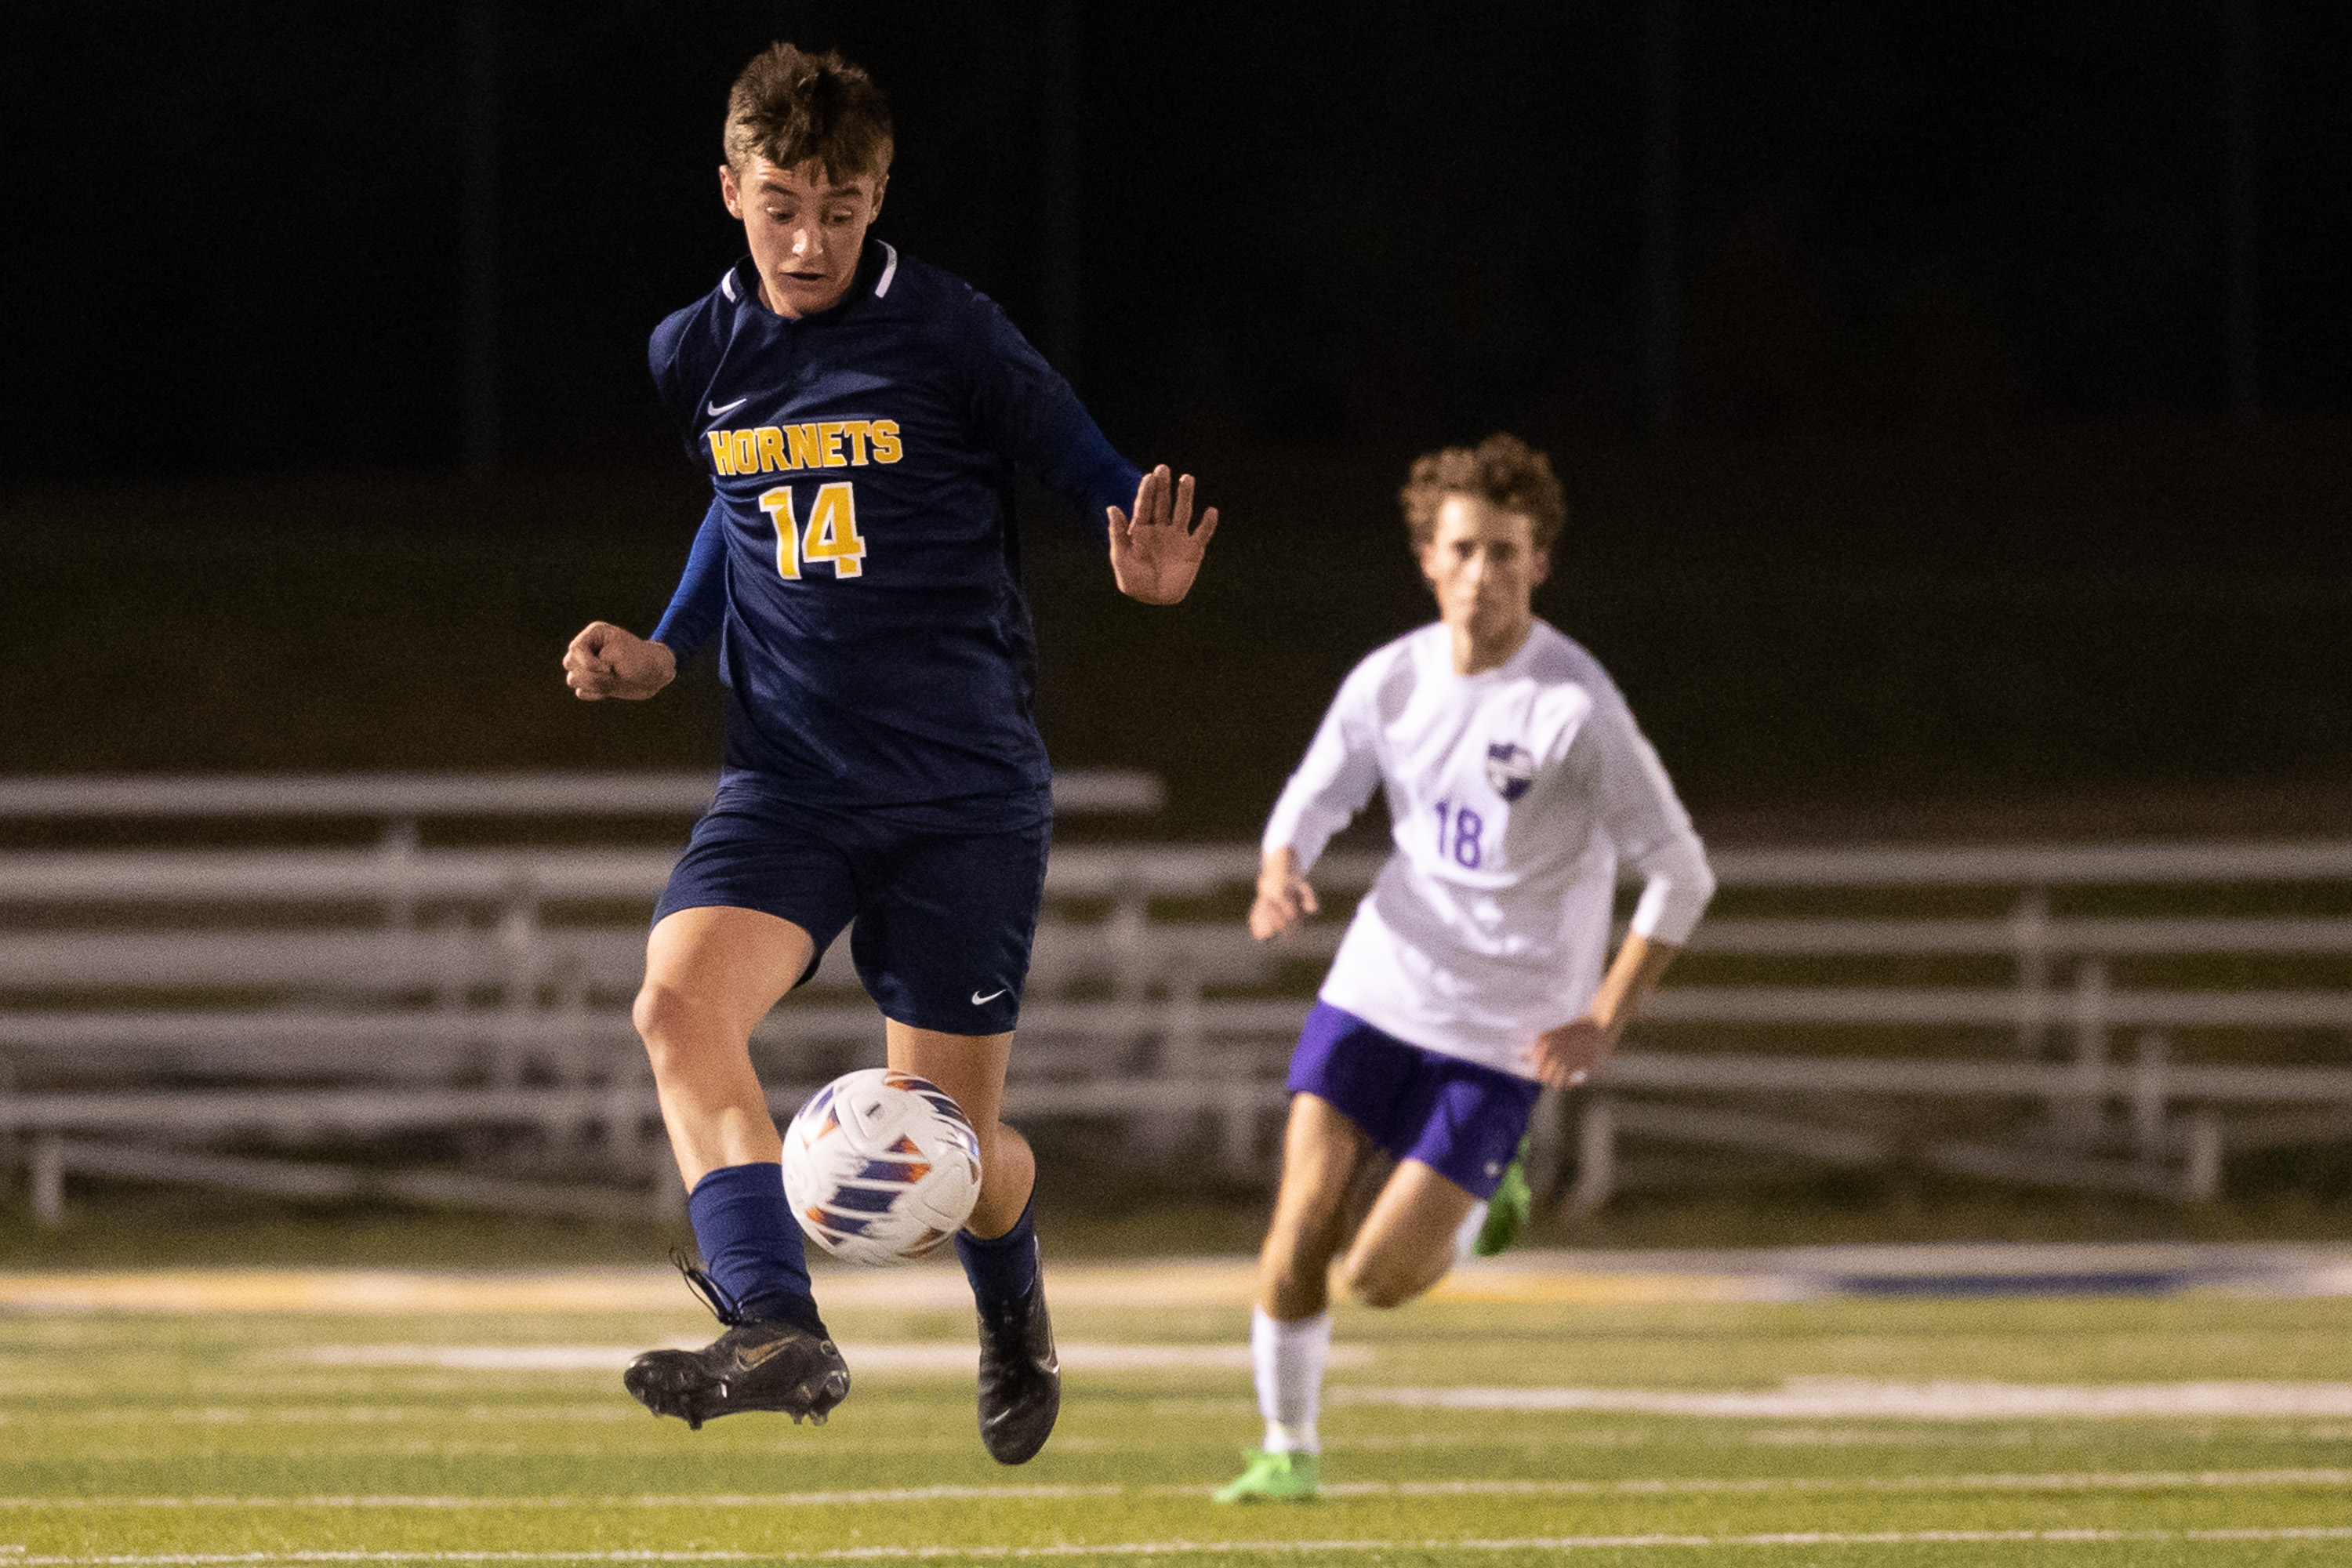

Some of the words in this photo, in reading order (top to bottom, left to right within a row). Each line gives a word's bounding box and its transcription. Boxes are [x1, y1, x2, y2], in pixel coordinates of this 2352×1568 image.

[708, 419, 903, 475] HORNETS
[759, 481, 866, 579] 14
[1435, 799, 1483, 869] 18
